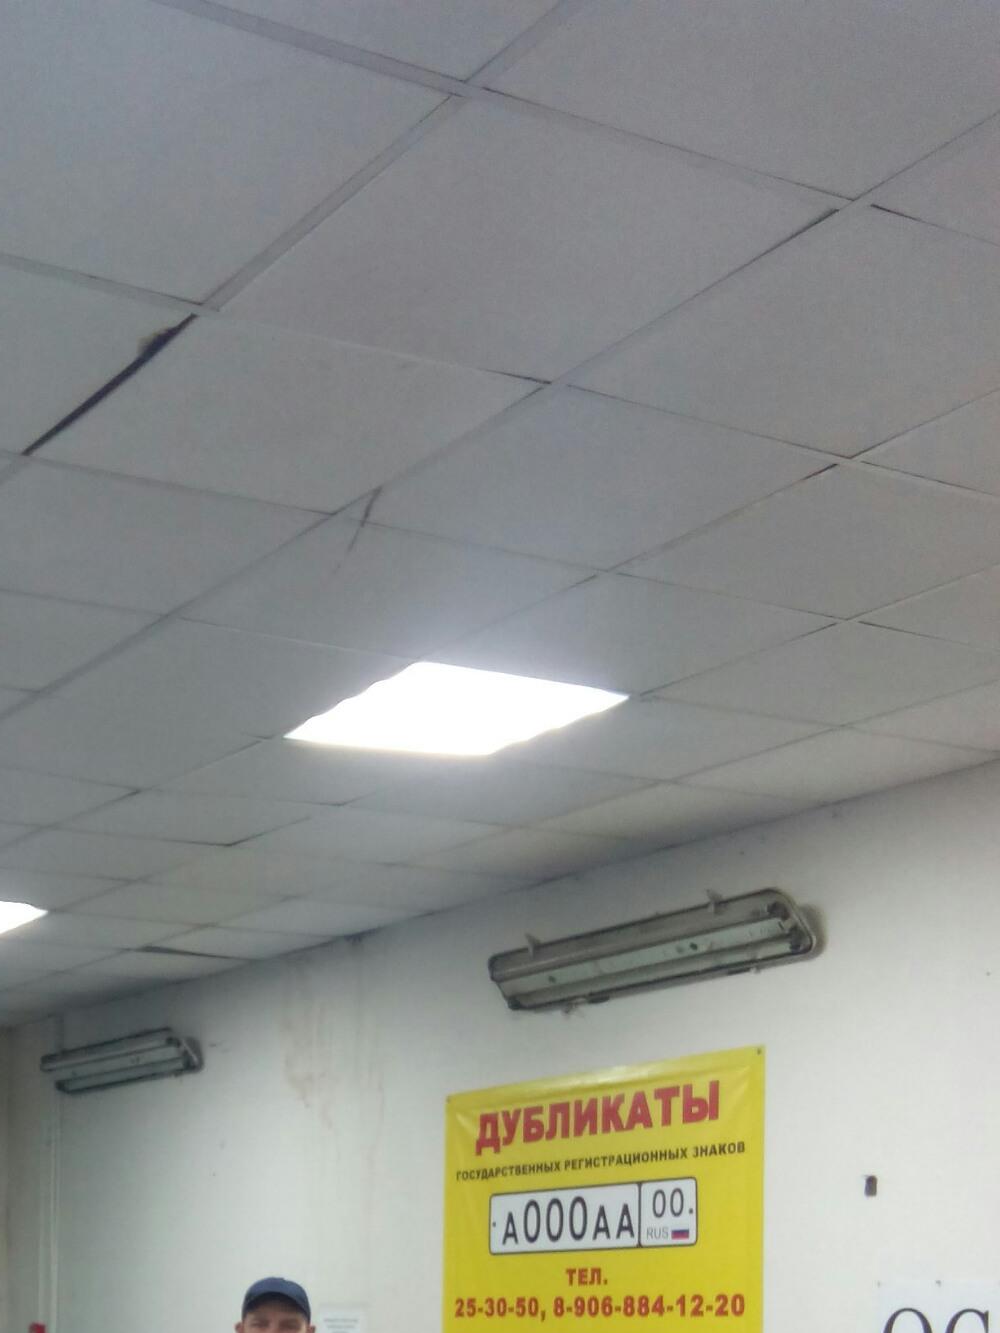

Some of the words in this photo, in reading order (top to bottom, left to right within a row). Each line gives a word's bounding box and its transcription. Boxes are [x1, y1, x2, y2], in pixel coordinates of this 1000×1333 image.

[475, 1080, 719, 1156] ДУБЛИКАТЫ
[456, 1161, 561, 1181] ГОСУДАРСТВЕННЫХ
[564, 1147, 688, 1171] РЕГИСТРАЦИОННЫХ
[693, 1141, 745, 1159] ЗНАКОВ
[646, 1227, 669, 1240] RUS
[566, 1267, 608, 1286] ТЕЛ.
[455, 1297, 546, 1322] 25-30-50,
[553, 1293, 745, 1317] 8-906-884-12-20
